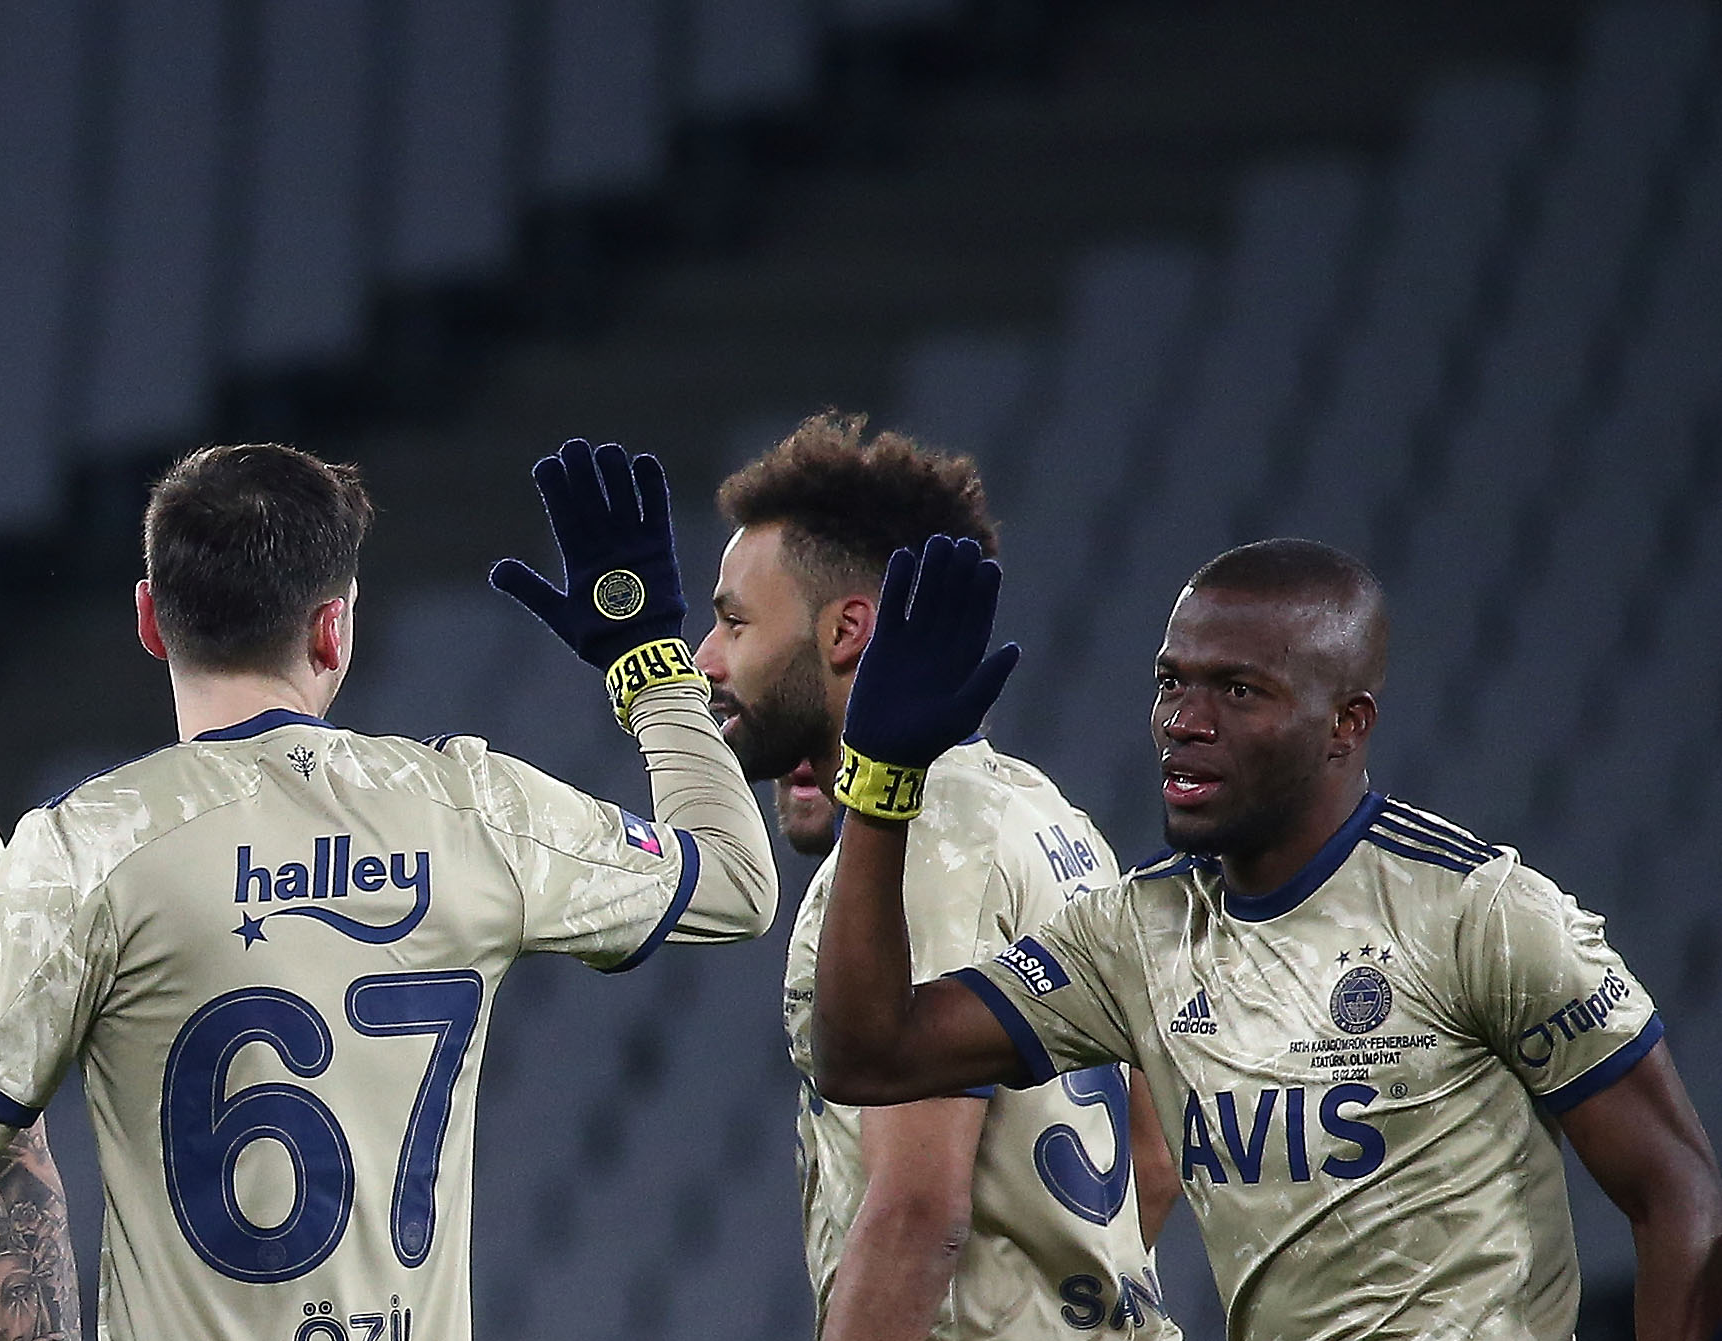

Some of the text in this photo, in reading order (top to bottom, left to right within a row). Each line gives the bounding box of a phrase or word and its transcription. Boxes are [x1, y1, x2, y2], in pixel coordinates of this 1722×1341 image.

[233, 835, 430, 942] halley
[1169, 1017, 1217, 1035] adidas
[160, 967, 483, 1284] 67
[1182, 1083, 1386, 1185] AVIS
